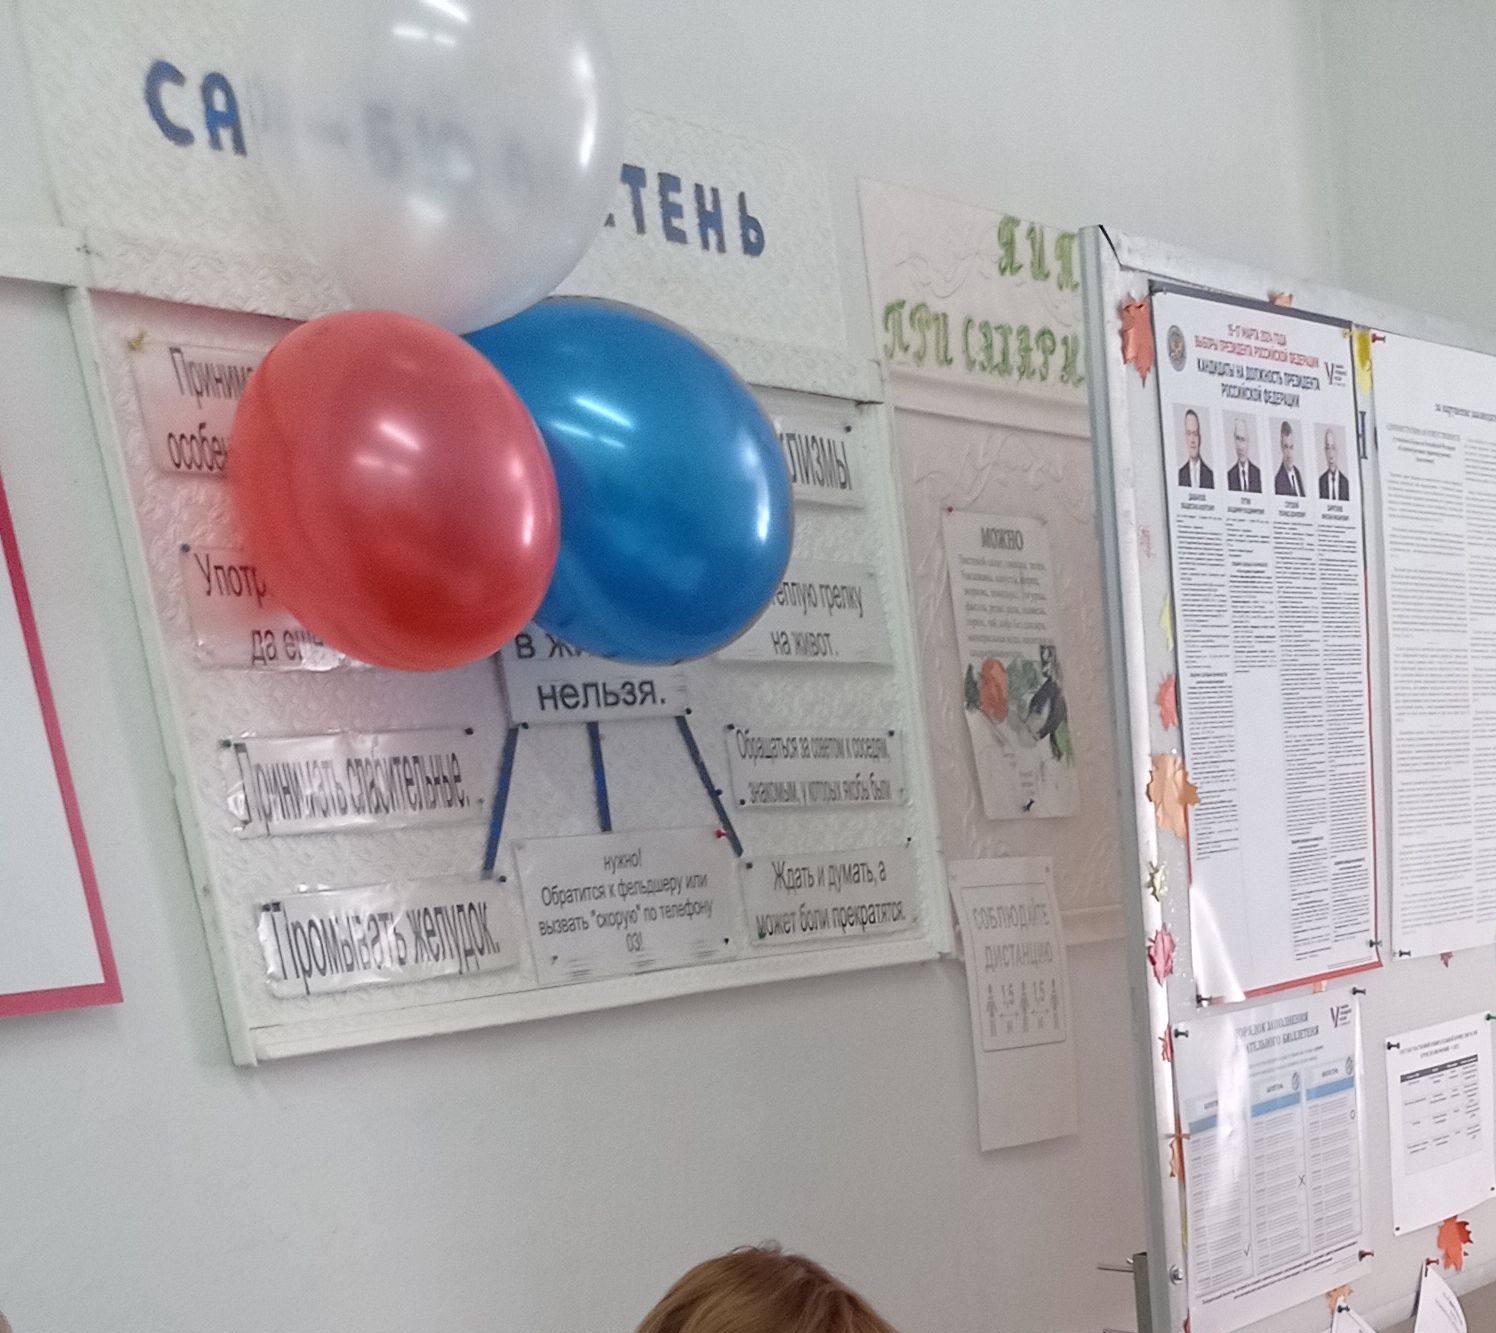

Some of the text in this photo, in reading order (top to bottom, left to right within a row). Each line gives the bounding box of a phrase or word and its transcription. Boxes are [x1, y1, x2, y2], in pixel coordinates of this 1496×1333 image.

[980, 526, 1024, 551] МОЖНО
[775, 581, 819, 617] еплую
[251, 630, 277, 666] да
[771, 631, 792, 657] на
[537, 679, 666, 711] нельзя.
[604, 848, 642, 872] нужно!
[617, 874, 682, 901] фельдшеру
[685, 875, 707, 890] или
[772, 861, 814, 892] Ждать
[878, 864, 887, 882] а
[539, 916, 589, 937] вызвать
[643, 907, 657, 923] по
[660, 898, 713, 923] телефону
[800, 902, 830, 933] боли
